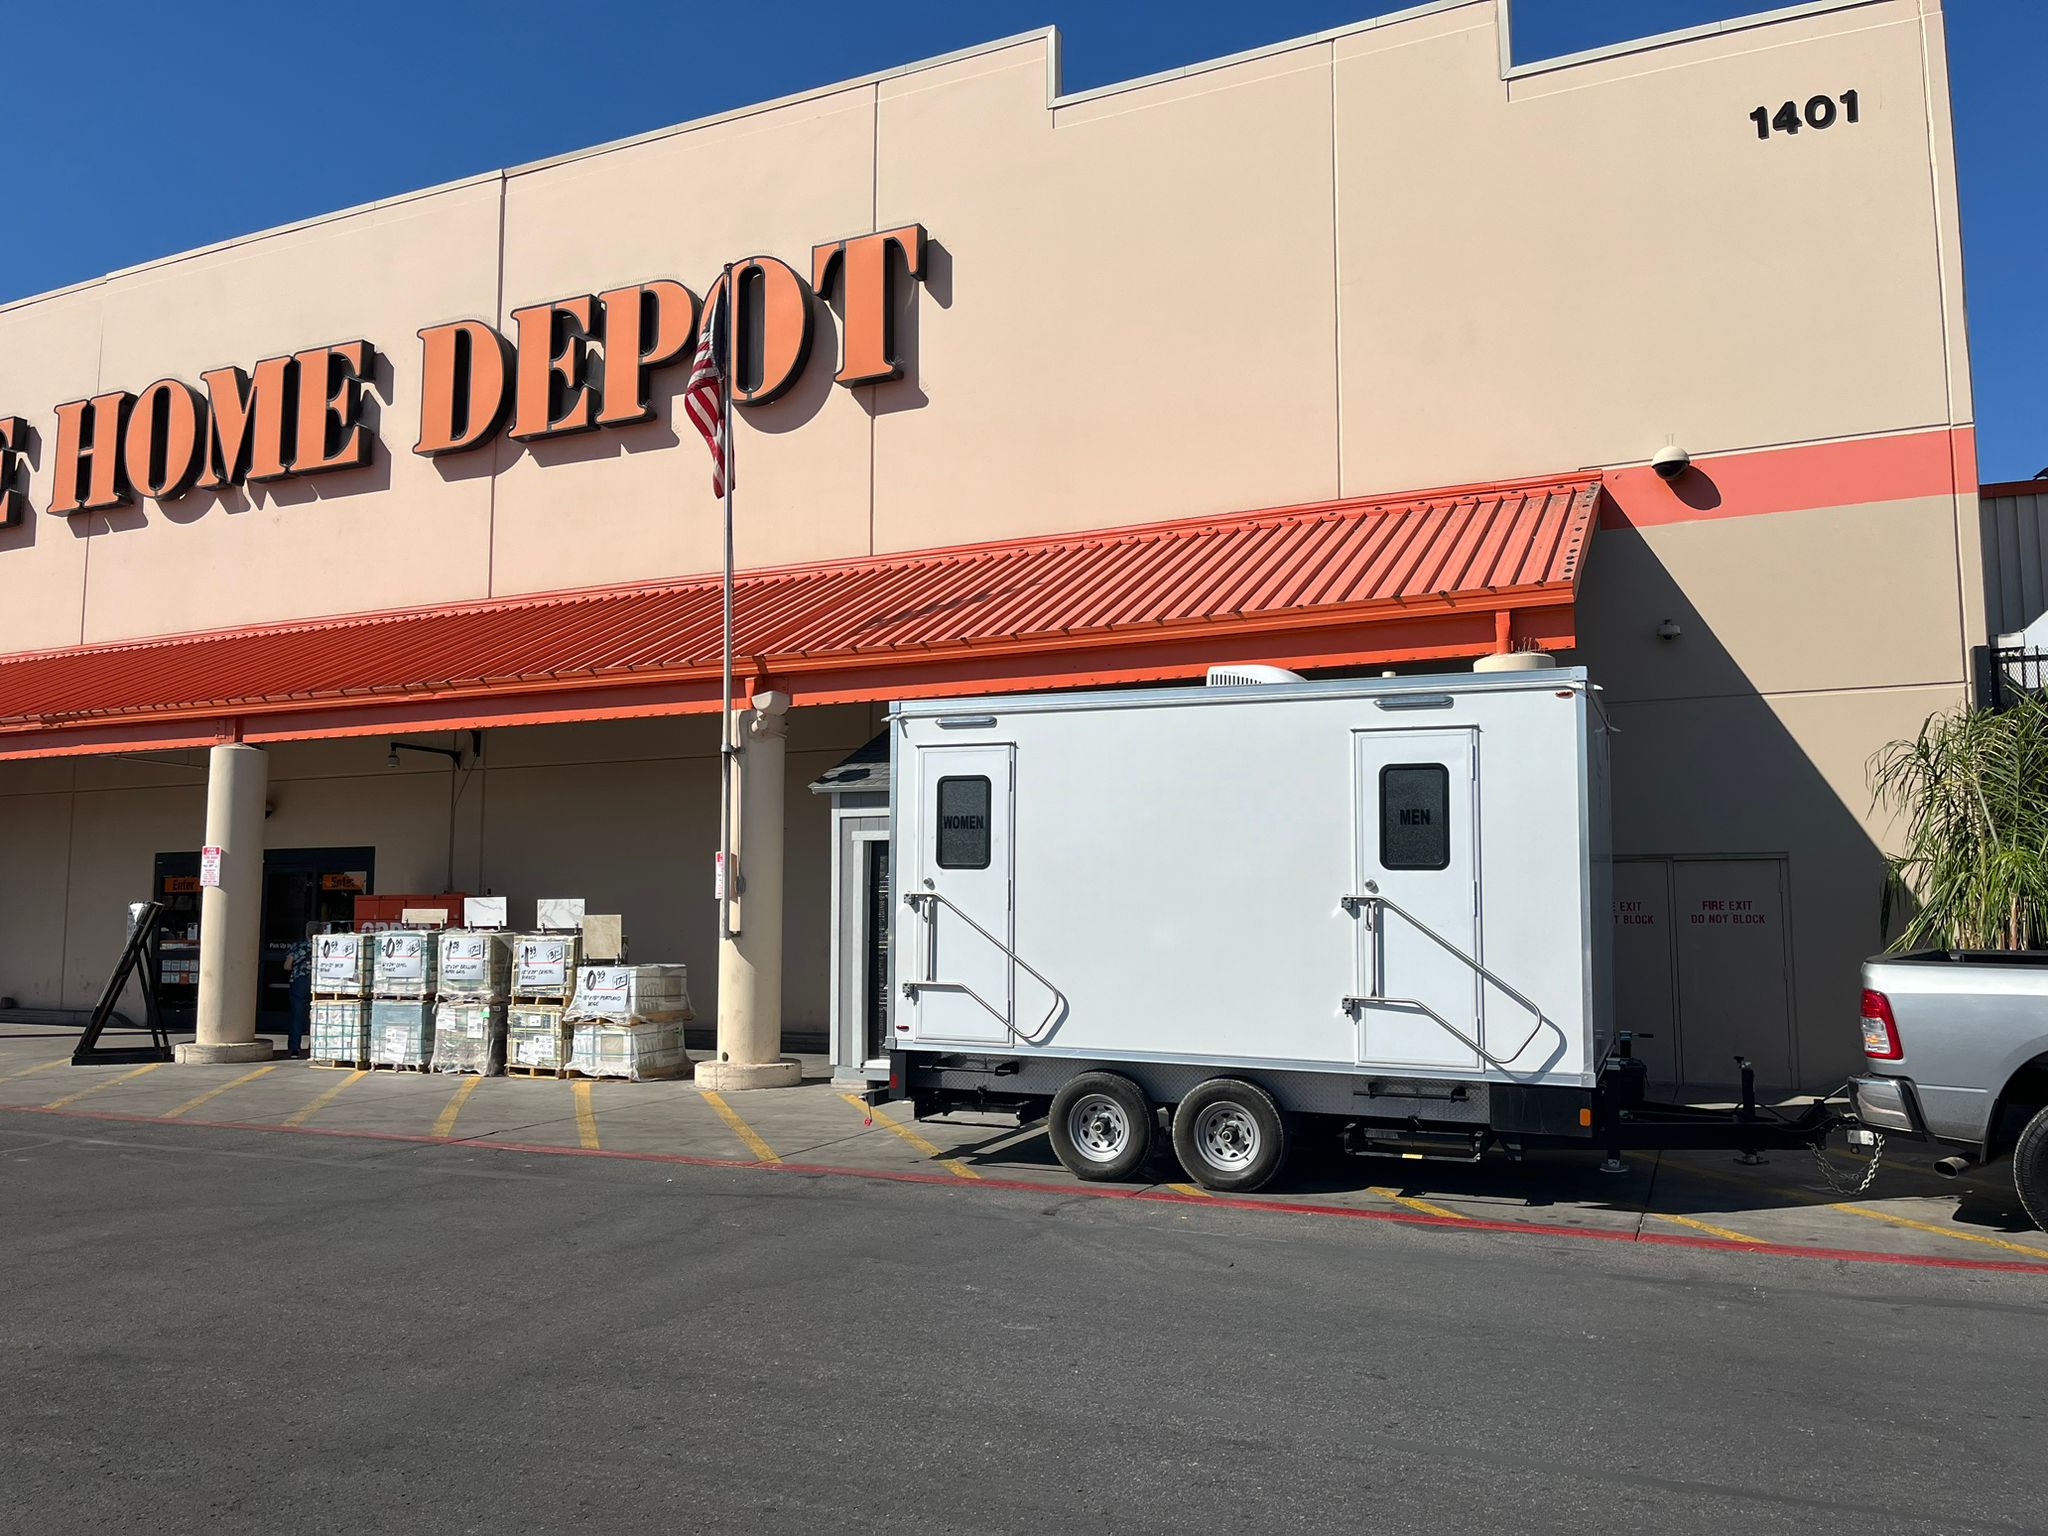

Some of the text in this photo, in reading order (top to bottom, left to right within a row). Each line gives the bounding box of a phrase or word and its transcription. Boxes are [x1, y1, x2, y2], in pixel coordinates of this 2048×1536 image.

[1749, 89, 1859, 140] 1401
[46, 339, 375, 518] HOME
[413, 223, 928, 458] DEPOT
[943, 815, 984, 830] WOMEN
[1399, 809, 1431, 825] MEN
[172, 879, 196, 891] Enter
[1620, 901, 1642, 911] EXIT
[1702, 900, 1752, 911] FIRE EXIT
[1623, 914, 1654, 924] BLOCK
[1691, 914, 1765, 924] DO NOT BLOCK
